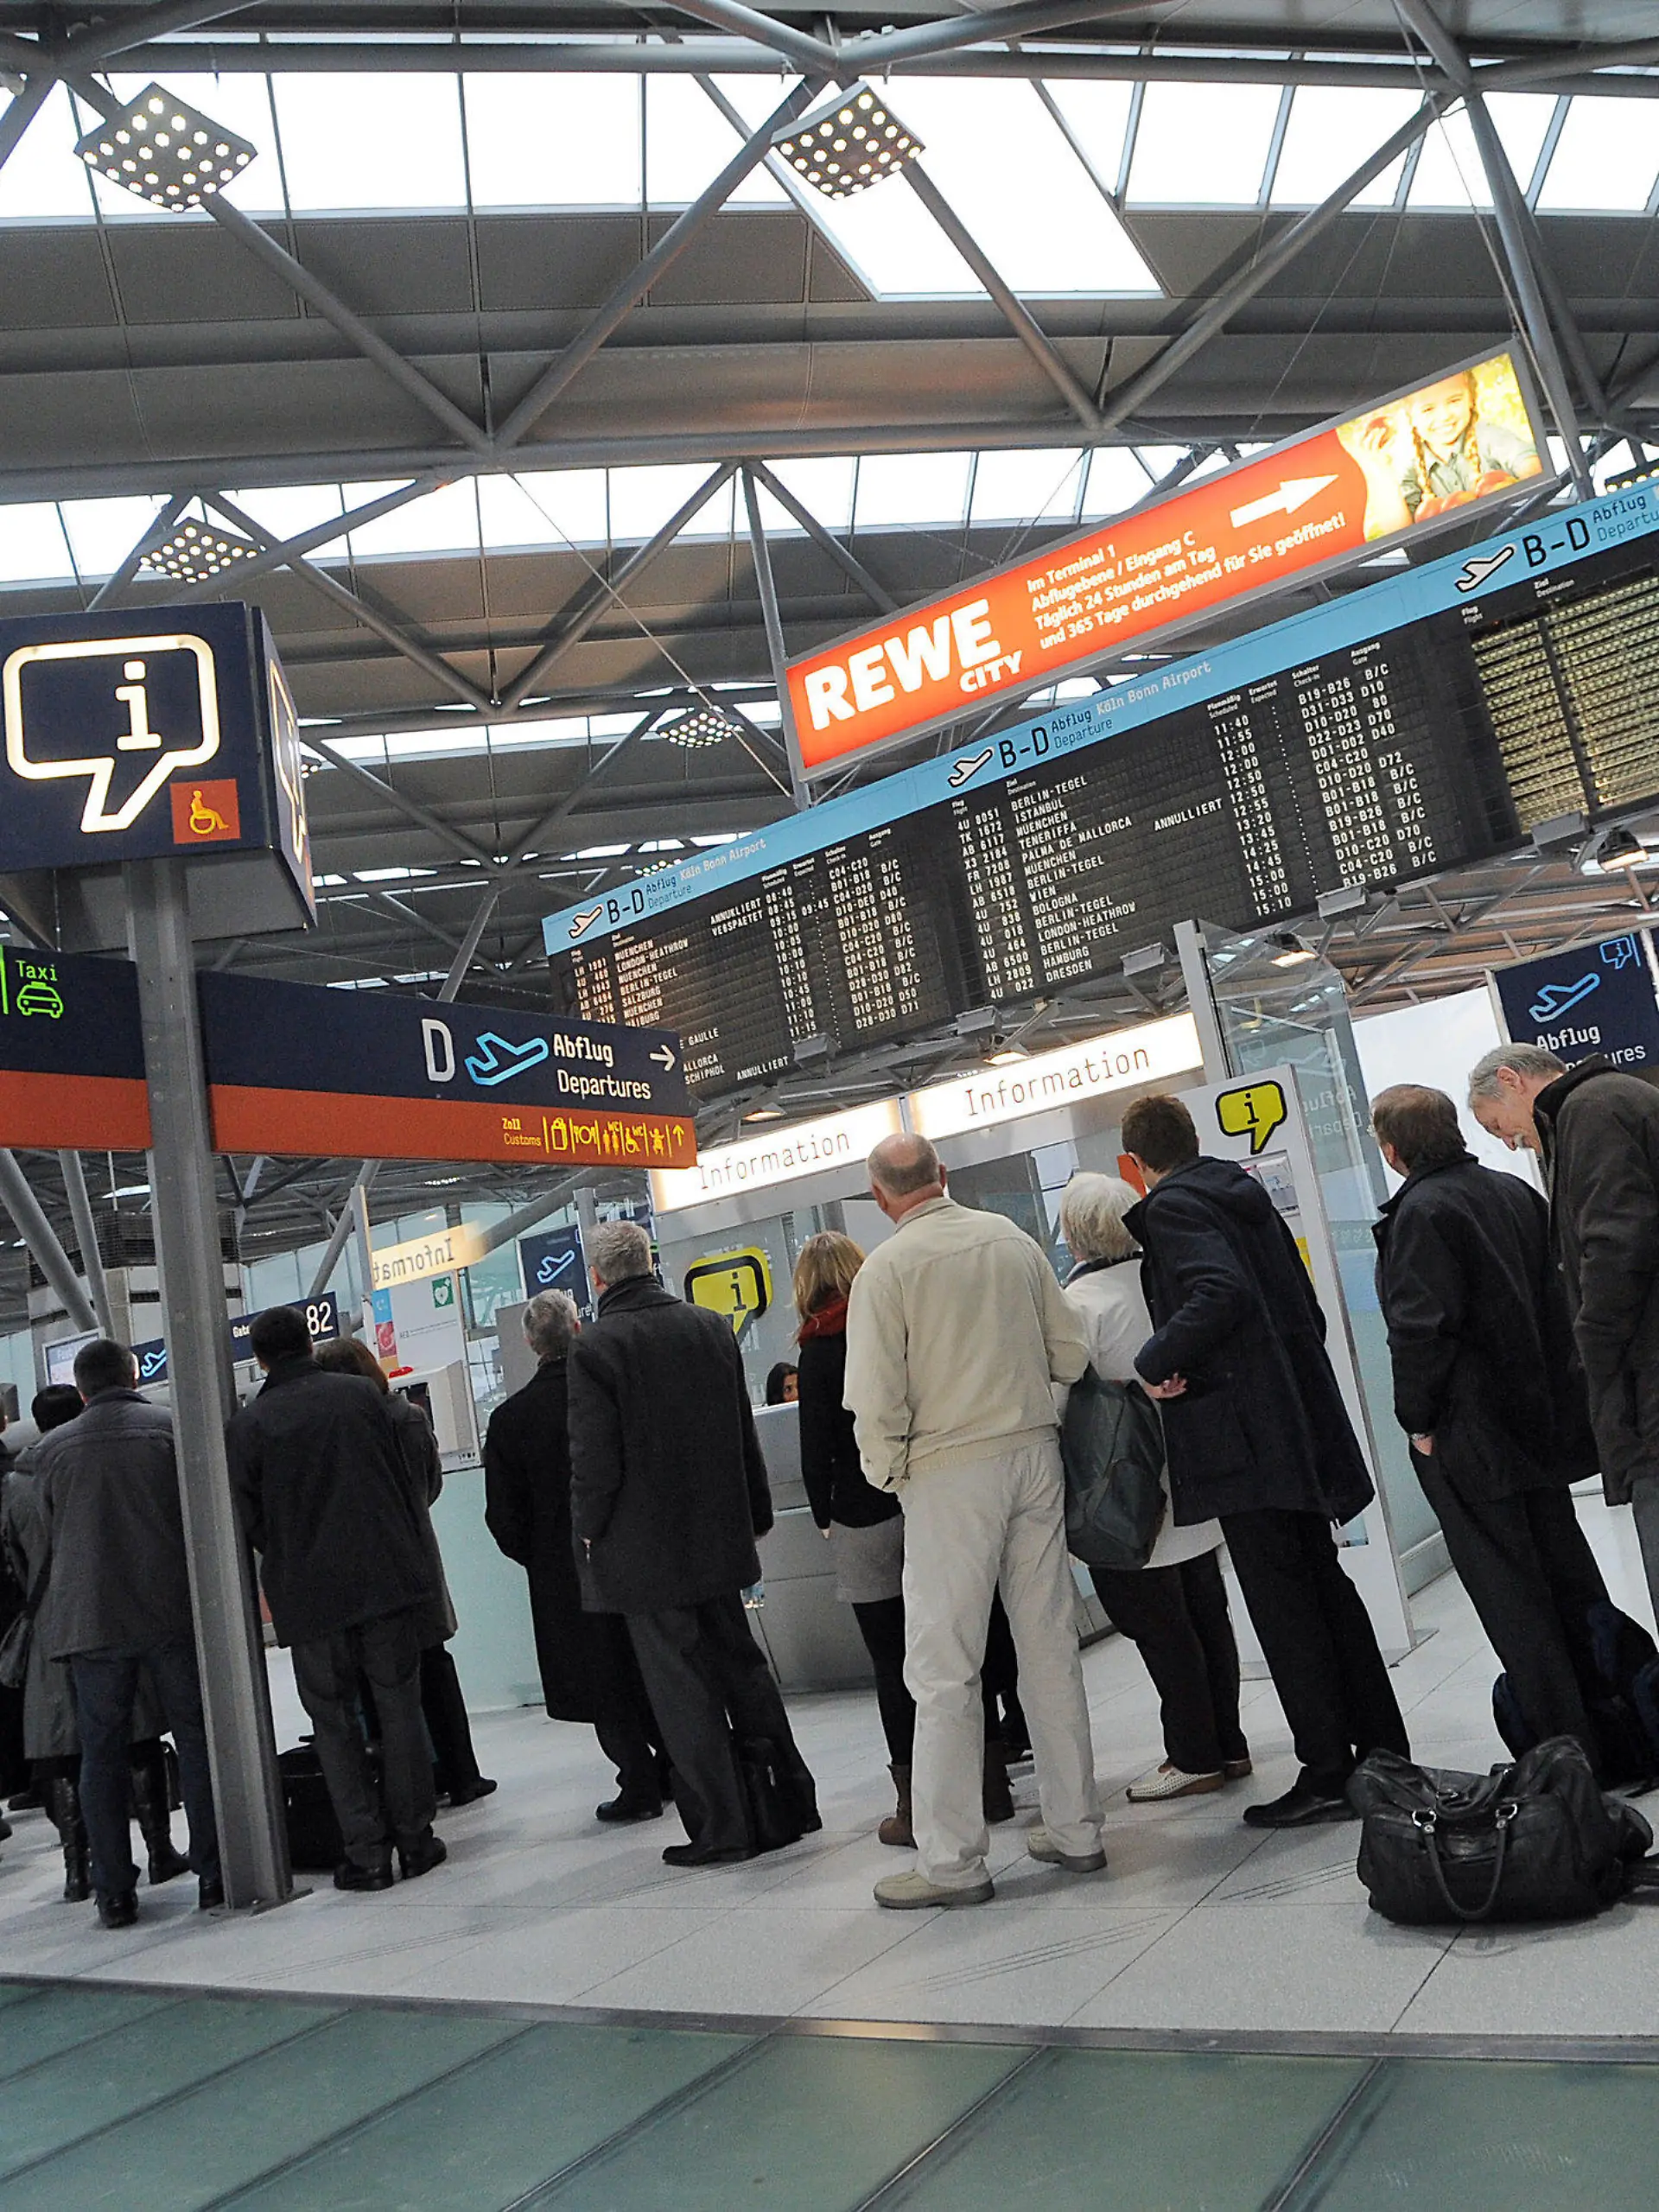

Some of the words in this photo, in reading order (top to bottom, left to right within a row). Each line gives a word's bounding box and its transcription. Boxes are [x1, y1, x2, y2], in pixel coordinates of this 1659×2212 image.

[1522, 518, 1590, 567] B-D
[1593, 496, 1646, 524] Abflug
[1027, 578, 1045, 593] Im
[1046, 549, 1105, 584] Terminal
[1108, 544, 1116, 557] 1
[1033, 569, 1115, 612] Abflugebene
[1125, 539, 1181, 571] Eingang
[1184, 531, 1195, 546] C
[1035, 598, 1083, 630] Täglich
[1084, 592, 1103, 609] 24
[1104, 570, 1161, 601] Stunden
[1164, 560, 1186, 576] am
[1187, 546, 1216, 565] Tag
[1040, 626, 1066, 649] und
[1068, 616, 1094, 638] 365
[1094, 605, 1129, 626] Tage
[1132, 562, 1223, 611] durchgehend
[1224, 555, 1246, 573] für
[1248, 545, 1272, 563] Sie
[1274, 512, 1345, 556] geöffnet!
[805, 599, 1001, 729] REWE
[960, 651, 1021, 692] CITY
[1290, 663, 1320, 680] Schalter
[999, 727, 1049, 768] B-D
[1052, 710, 1091, 733] Abflug
[1096, 698, 1124, 715] Köln
[1128, 684, 1159, 702] Bonn
[1163, 662, 1211, 690] Airport
[1052, 716, 1115, 750] Departure
[958, 819, 969, 830] 4U
[1011, 776, 1087, 811] BERLIN-TEGEL
[1215, 715, 1249, 735] 11:40
[1299, 677, 1351, 704] B19-B26
[1365, 664, 1389, 680] B/C
[959, 831, 972, 844] TK
[979, 821, 1002, 837] 1672
[1015, 798, 1065, 823] ISTANBUL
[1217, 728, 1252, 749] 11:55
[1301, 691, 1354, 718] D31-D33
[1361, 680, 1383, 697] D10
[963, 844, 975, 856] AB
[981, 834, 1003, 850] 6117
[1016, 810, 1068, 837] MUENCHEN
[1220, 742, 1255, 762] 12:00
[1305, 705, 1357, 733] D10-D20
[964, 857, 976, 869] X3
[983, 846, 1007, 863] 2184
[1019, 822, 1077, 849] TENERIFFA
[1224, 756, 1258, 776] 12:00
[1308, 719, 1361, 747] D22-D23
[1368, 709, 1391, 725] D70
[967, 870, 980, 882] FR
[985, 859, 1010, 876] 7208
[1022, 844, 1054, 863] PALMA
[1059, 837, 1072, 849] DE
[1078, 817, 1132, 842] MALLORCA
[1227, 770, 1262, 790] 12:50
[1312, 734, 1364, 760] D01-D02
[1371, 723, 1395, 740] D40
[969, 882, 982, 895] LH
[988, 872, 1012, 888] 1987
[1024, 850, 1076, 876] MUENCHEN
[1155, 798, 1221, 830] ANNULLIERT
[1230, 784, 1265, 804] 12:50
[1316, 747, 1368, 774] C04-C20
[973, 896, 985, 908] AB
[1027, 855, 1104, 889] BERLIN-TEGEL
[1234, 798, 1268, 817] 12:55
[1319, 762, 1371, 789] D10-D20
[1378, 752, 1402, 768] D72
[976, 909, 988, 920] 4U
[999, 899, 1018, 912] 752
[1029, 886, 1056, 902] WIEN
[1236, 811, 1271, 831] 13:20
[1322, 776, 1375, 803] B01-B18
[1390, 763, 1414, 779] B/C
[607, 889, 644, 924] B-D
[646, 876, 677, 894] Abflug
[703, 855, 727, 871] Bonn
[729, 839, 766, 861] Airport
[830, 857, 868, 880] C04-C20
[978, 922, 990, 933] 4U
[1002, 912, 1020, 926] 838
[1033, 893, 1078, 915] BOLOGNA
[1240, 825, 1274, 845] 13:45
[1325, 791, 1378, 817] B01-B18
[1393, 778, 1417, 794] B/C
[981, 935, 993, 946] 4U
[1035, 895, 1113, 929] BERLIN-TEGEL
[1243, 840, 1278, 859] 14:25
[1329, 805, 1382, 831] B19-B26
[1397, 792, 1421, 809] B/C
[983, 948, 995, 959] 4U
[1007, 938, 1026, 951] 464
[1038, 901, 1135, 942] LONDON-HEATHROW
[1246, 854, 1281, 874] 14:45
[1332, 819, 1386, 846] B01-B18
[1401, 807, 1425, 823] B/C
[646, 882, 693, 911] Departure
[15, 959, 58, 982] Taxi
[617, 938, 688, 973] LONDON-HEATHROW
[620, 968, 677, 995] BERLIN-TEGEL
[844, 944, 884, 966] C04-C20
[622, 986, 661, 1007] SALZBURG
[422, 1019, 454, 1082] D
[554, 1034, 613, 1066] Abflug
[689, 1027, 718, 1046] GAULLE
[790, 1020, 817, 1037] 11:15
[1536, 1026, 1601, 1052] Abflug
[557, 1070, 651, 1099] Departures
[737, 1056, 788, 1080] ANNULLIERT
[965, 1045, 1151, 1117] Information
[502, 1118, 521, 1131] Zoll
[504, 1133, 542, 1147] Customs
[696, 1129, 850, 1191] Information
[305, 1301, 334, 1336] 82
